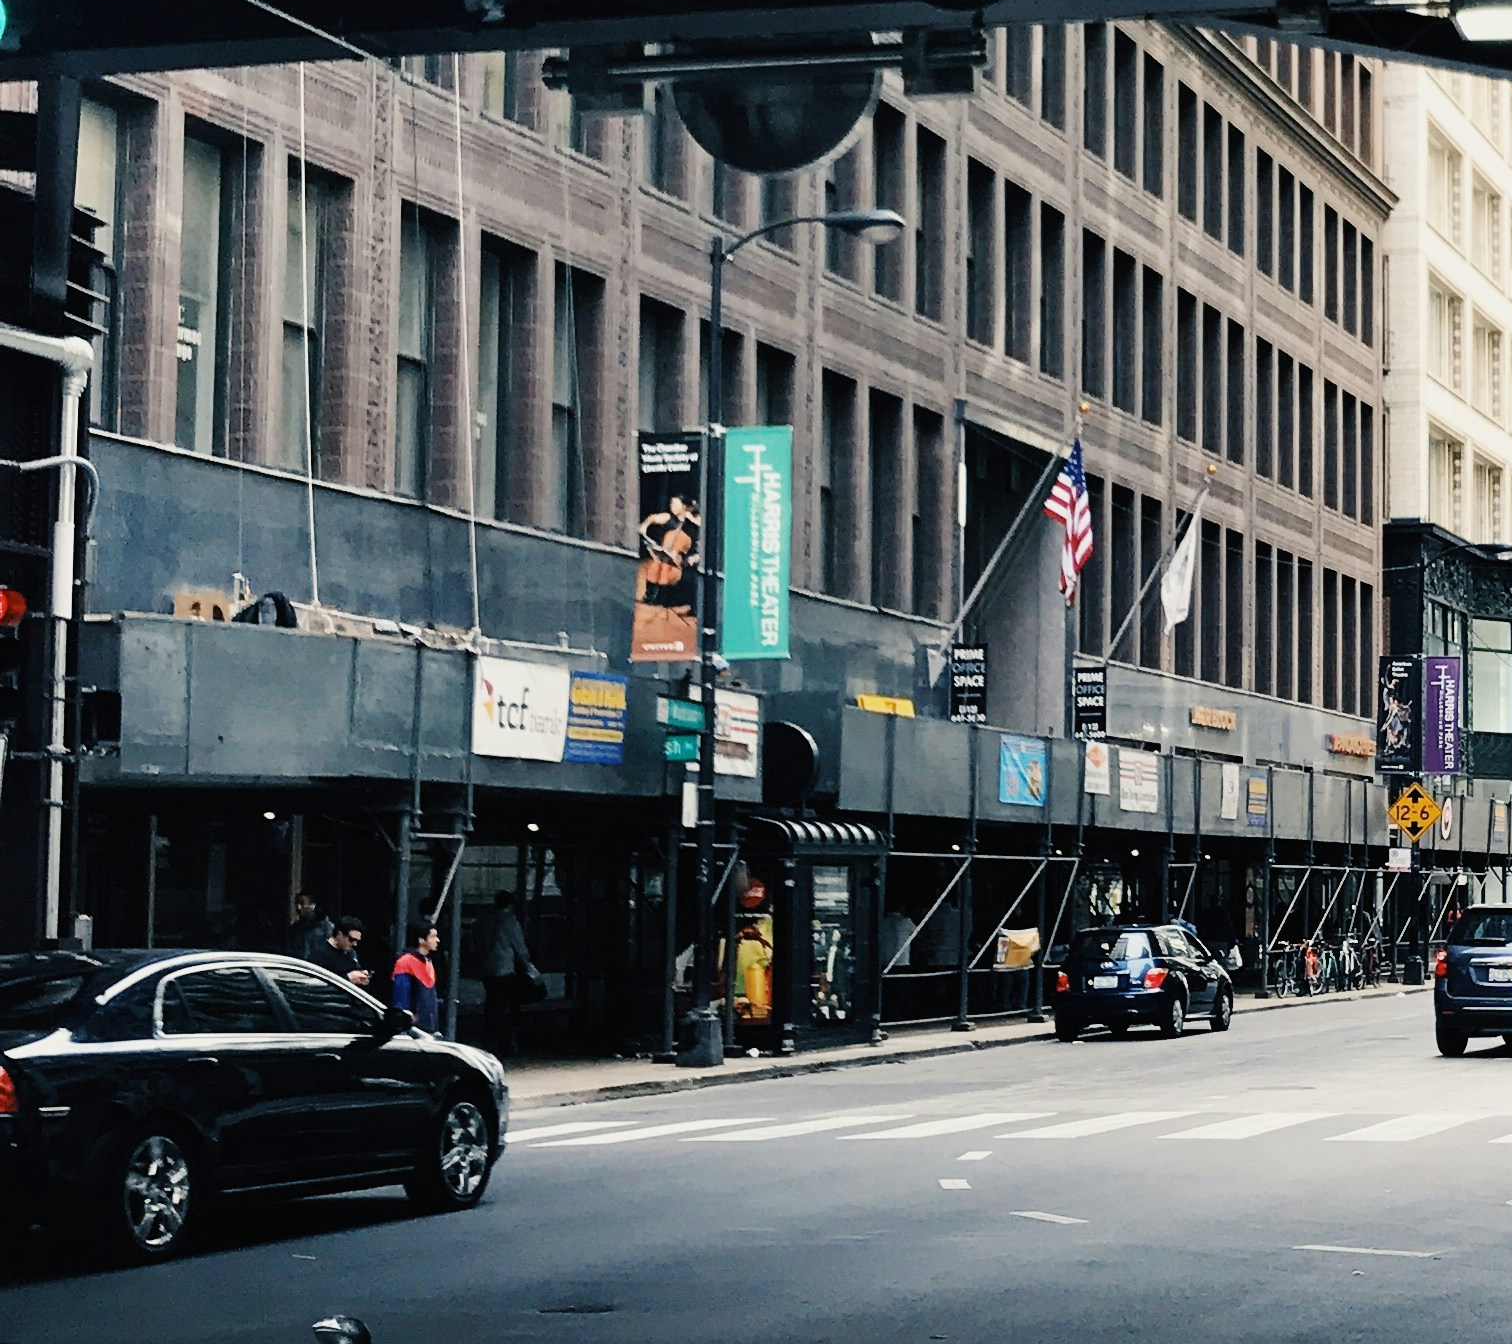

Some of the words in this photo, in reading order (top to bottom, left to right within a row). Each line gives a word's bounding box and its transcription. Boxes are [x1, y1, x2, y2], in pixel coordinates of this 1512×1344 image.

[762, 472, 781, 554] HARRIS
[760, 554, 780, 646] THEATER
[953, 675, 985, 687] SPACE
[1076, 696, 1104, 707] SPACE
[1445, 679, 1455, 722] HARRIS
[497, 687, 530, 730] tcf
[1444, 722, 1455, 769] THEATER
